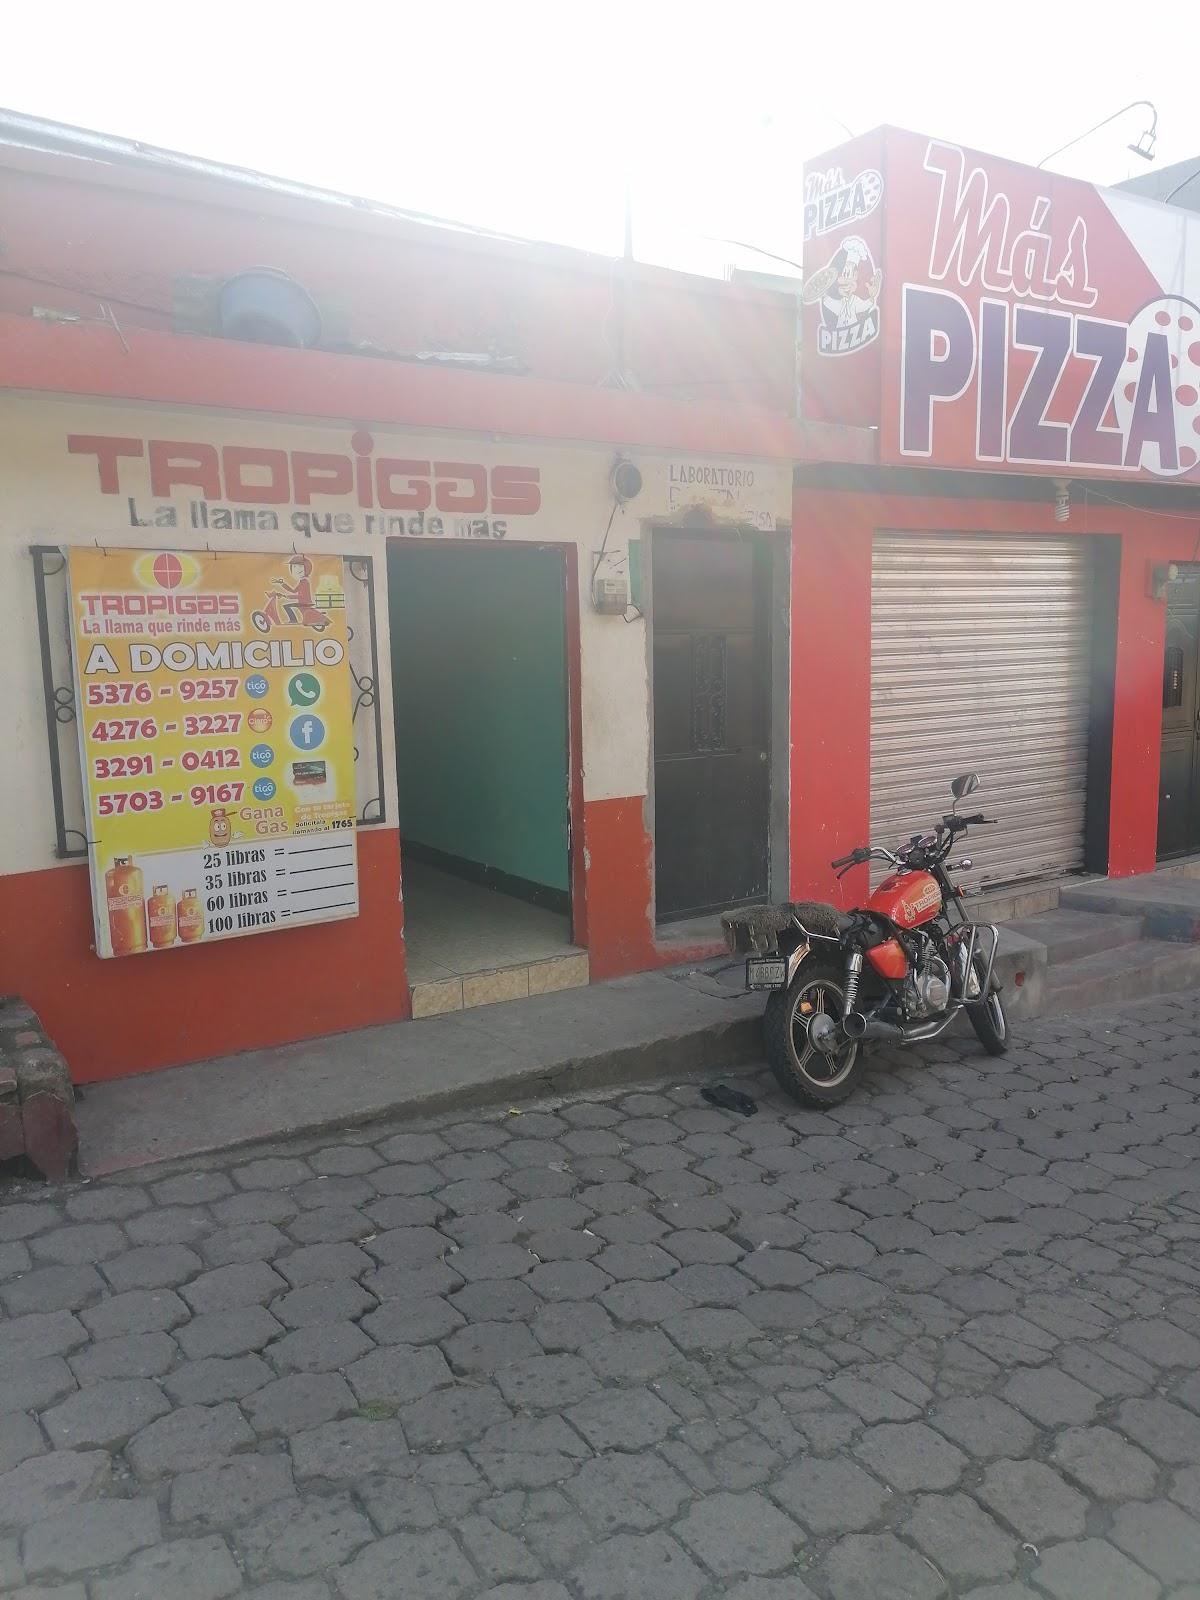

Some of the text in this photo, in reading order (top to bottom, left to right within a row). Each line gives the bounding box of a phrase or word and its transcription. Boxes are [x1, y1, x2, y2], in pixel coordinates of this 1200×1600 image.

[803, 183, 867, 241] PIZZA
[924, 138, 1098, 309] Más
[821, 317, 876, 350] PIZZA
[900, 283, 1180, 472] PIZZA
[669, 464, 754, 487] LABORATORIO
[128, 497, 177, 527] La
[190, 501, 279, 530] llama
[291, 511, 355, 538] que
[365, 510, 445, 536] rinde
[83, 617, 241, 637] La llama que rinde más
[84, 638, 345, 675] A DOMICILIO
[88, 683, 151, 705] 5376
[179, 679, 239, 700] 9257
[92, 720, 157, 741] 4276
[185, 714, 242, 736] 3227
[96, 755, 153, 778] 3291
[182, 749, 240, 771] 0412
[99, 791, 164, 815] 5703
[191, 782, 245, 805] 9167
[240, 806, 284, 821] Gana
[331, 819, 353, 829] 1765
[256, 820, 289, 835] Gas
[203, 852, 222, 869] 25
[226, 848, 266, 867] libras
[205, 874, 223, 891] 35
[227, 869, 267, 888] libras
[206, 895, 225, 912] 60
[229, 890, 268, 909] libras
[208, 915, 233, 934] 100
[237, 909, 276, 928] libras
